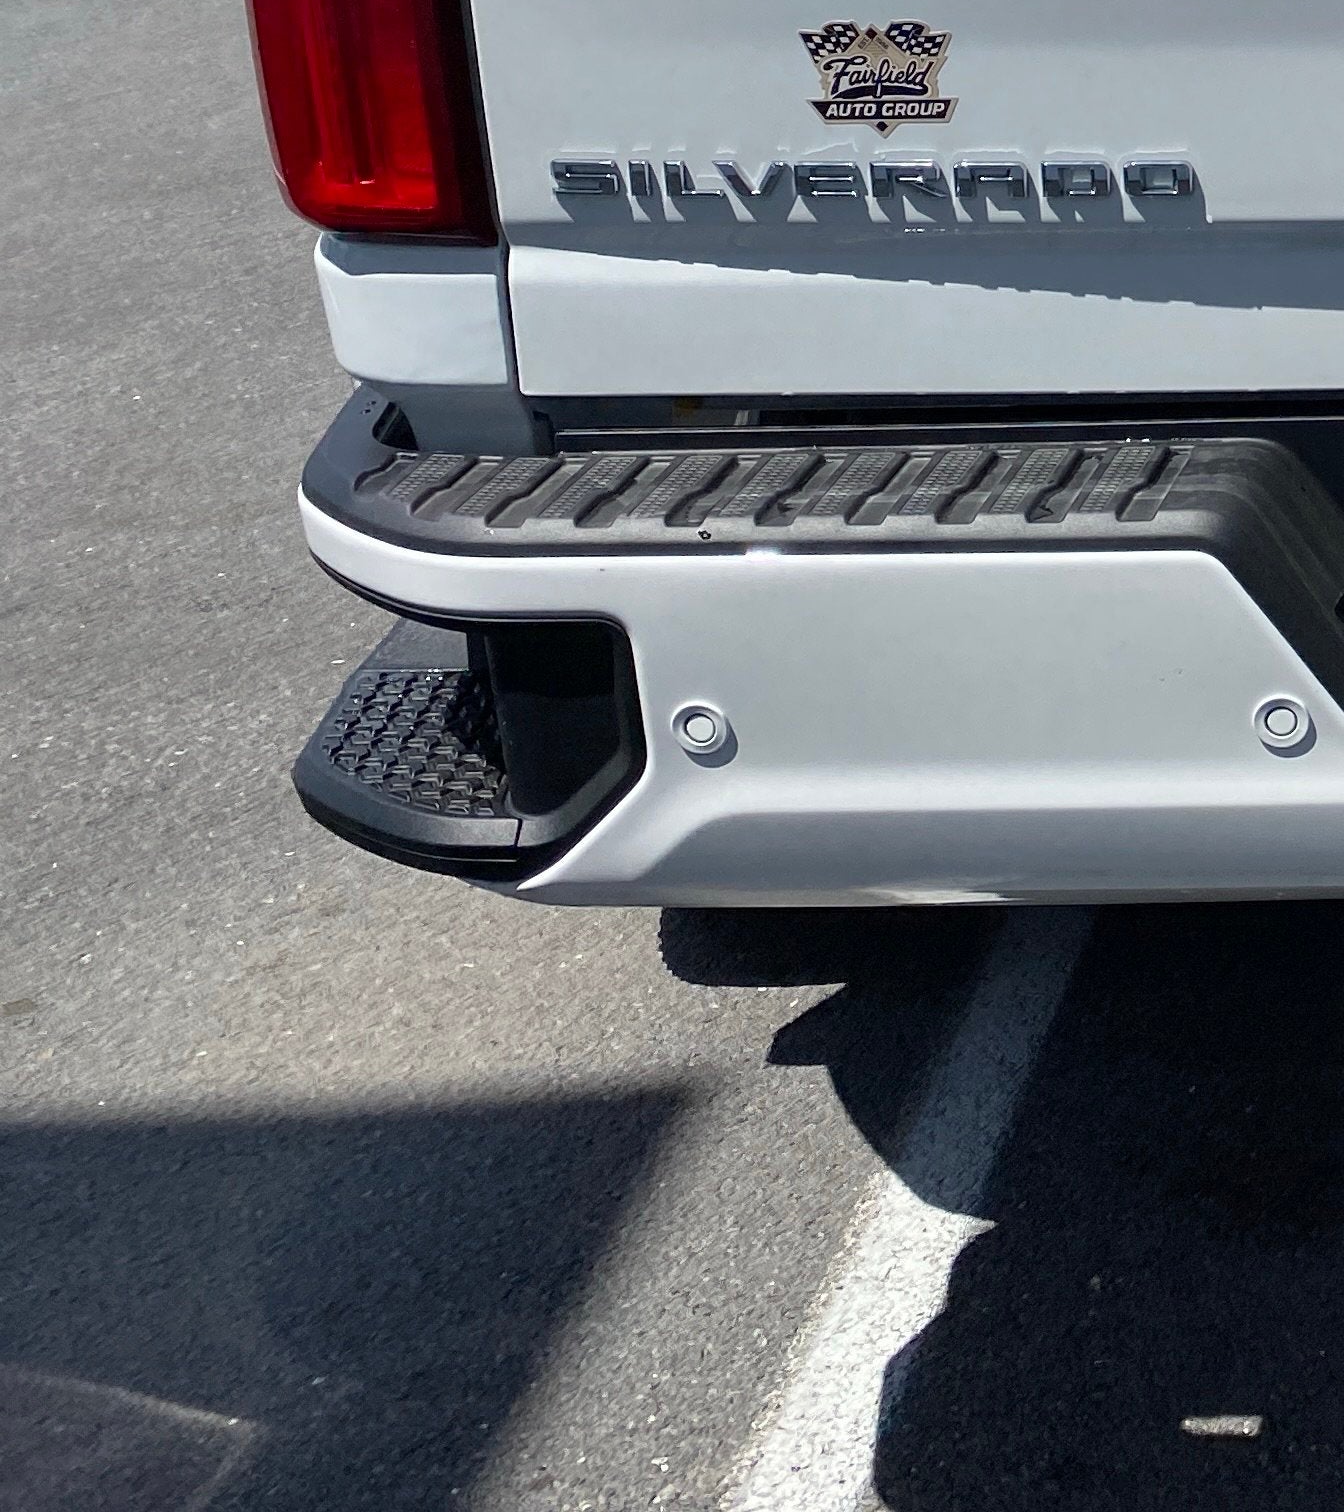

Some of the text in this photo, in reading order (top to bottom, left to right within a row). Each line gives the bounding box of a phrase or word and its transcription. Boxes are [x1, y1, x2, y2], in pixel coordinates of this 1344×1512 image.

[823, 55, 935, 97] Fairfield
[826, 102, 945, 117] AUTO GROUP
[550, 159, 1195, 198] SILVERADO
